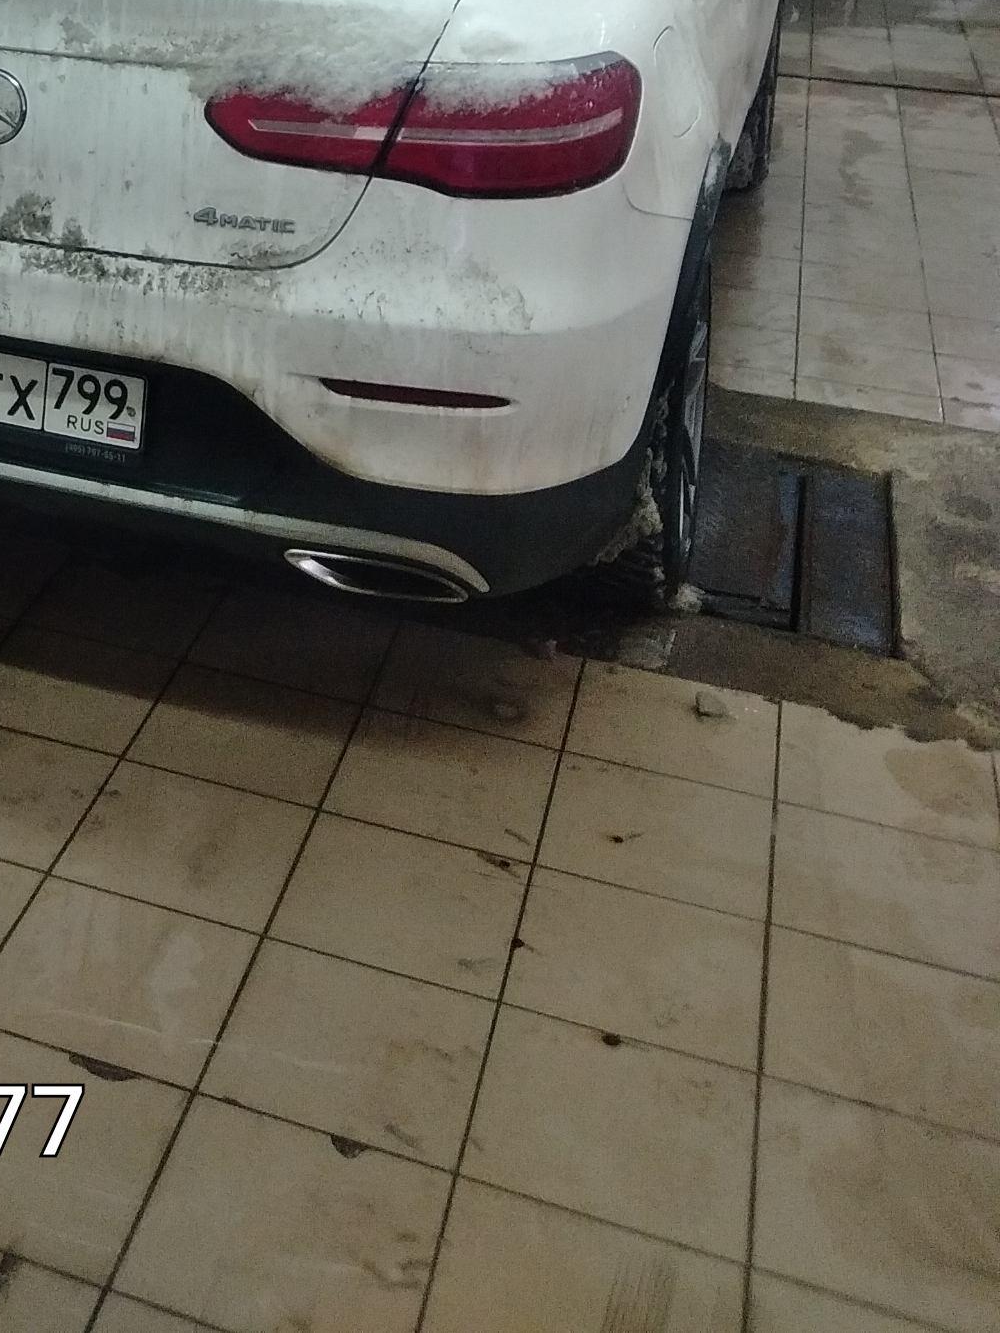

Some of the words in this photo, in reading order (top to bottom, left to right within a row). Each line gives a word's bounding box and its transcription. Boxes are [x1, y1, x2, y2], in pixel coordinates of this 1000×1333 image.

[193, 206, 296, 235] 4MATIC
[51, 367, 129, 421] 799
[66, 414, 105, 436] RUS
